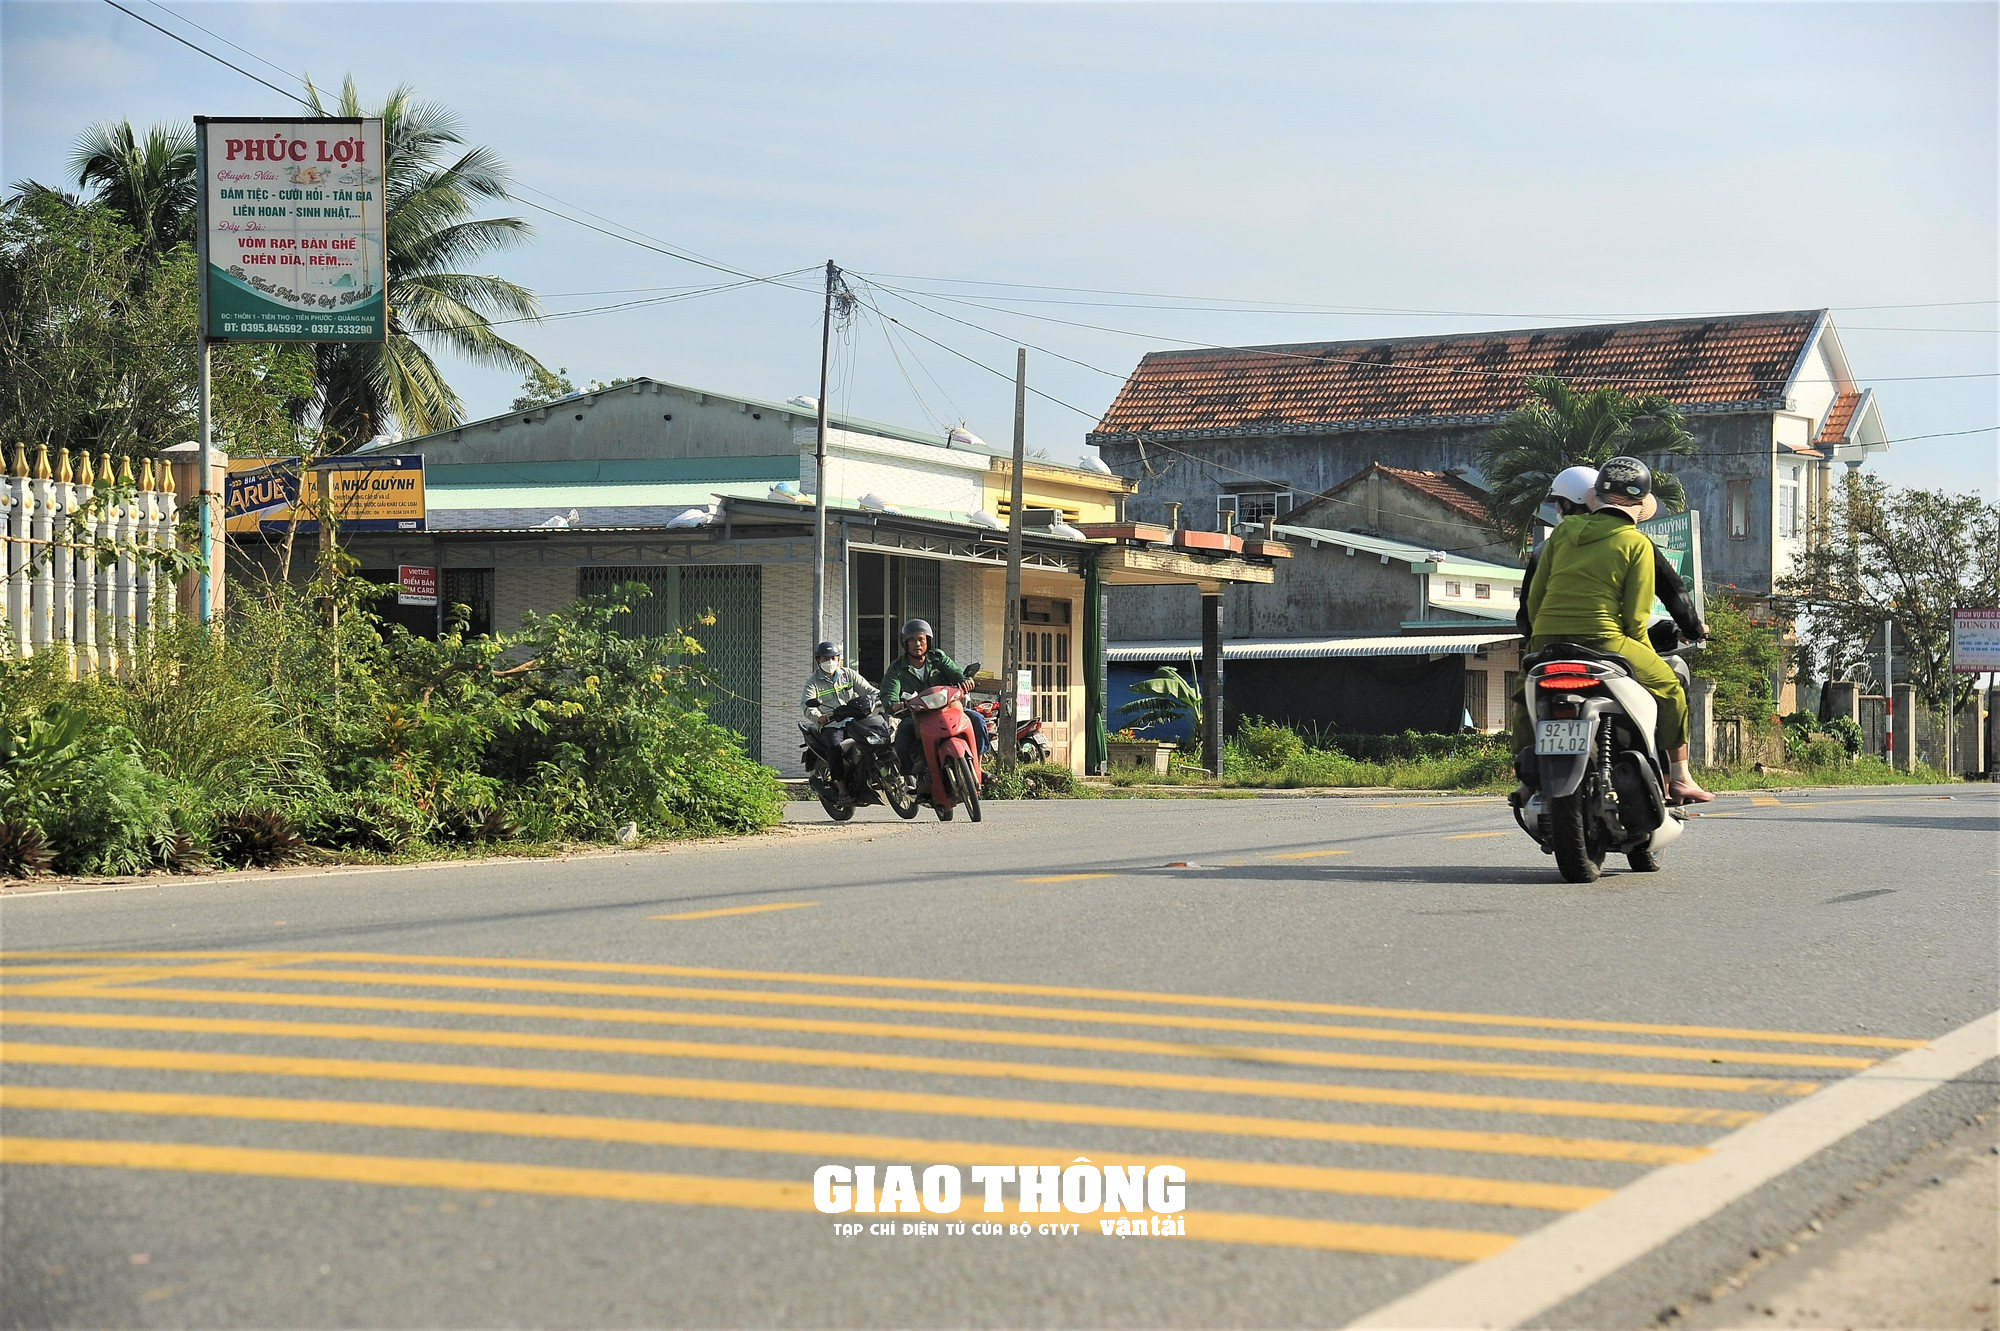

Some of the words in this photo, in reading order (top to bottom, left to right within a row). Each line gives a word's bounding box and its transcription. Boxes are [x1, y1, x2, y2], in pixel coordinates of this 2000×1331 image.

[225, 133, 307, 162] PHÚC
[316, 137, 366, 168] LỢI
[217, 170, 252, 183] Chuyên
[220, 188, 244, 200] ĐÁM
[246, 188, 268, 202] TIỆC
[278, 188, 302, 200] CƯỚI
[306, 187, 322, 200] HỎI
[332, 188, 354, 201] TÂN
[356, 191, 372, 202] GIA
[232, 204, 255, 217] LIÊN
[258, 206, 286, 217] HOAN
[296, 207, 320, 218] SINH
[238, 236, 266, 248] VÒM
[270, 238, 298, 250] RẠP,
[302, 238, 328, 249] BÀN
[332, 236, 357, 250] GHẾ
[242, 252, 276, 265] CHÉN
[224, 323, 238, 332] ĐT:
[240, 324, 302, 334] 0395.845592
[312, 324, 373, 334] 0397.533290
[372, 476, 415, 490] QUỲNH
[226, 478, 284, 510] ARUE
[1658, 518, 1688, 534] QUỲNH
[404, 576, 420, 586] ĐIỂM
[422, 578, 434, 586] BÁN
[417, 586, 434, 594] CARD
[1546, 722, 1580, 737] 92-V1
[1540, 738, 1586, 752] 114.02
